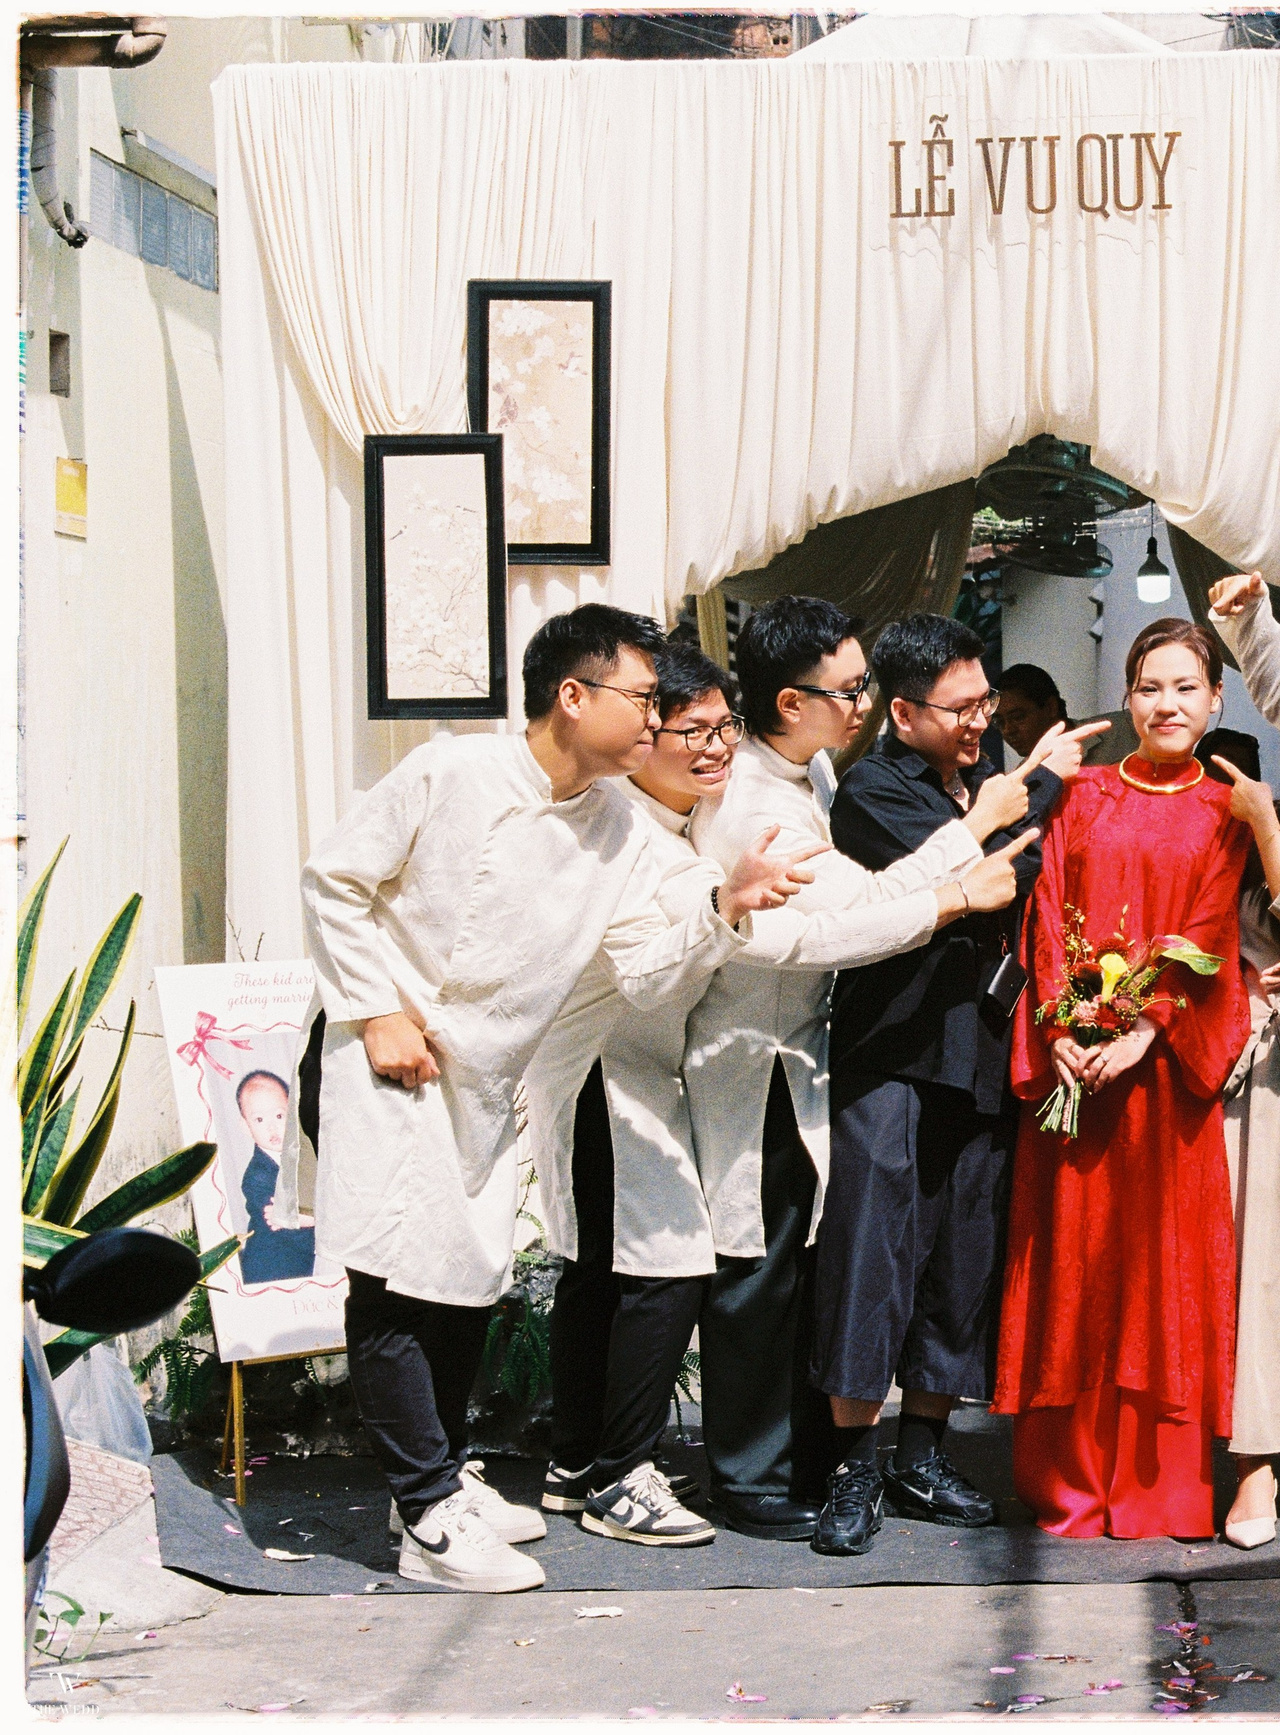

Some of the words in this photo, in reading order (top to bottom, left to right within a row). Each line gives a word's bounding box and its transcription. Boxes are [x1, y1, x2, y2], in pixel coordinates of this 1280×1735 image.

[888, 114, 955, 218] LỄ
[975, 135, 1061, 216] VU
[1076, 131, 1182, 219] QUY
[234, 972, 269, 988] These
[272, 971, 293, 986] kid
[227, 995, 268, 1011] getting
